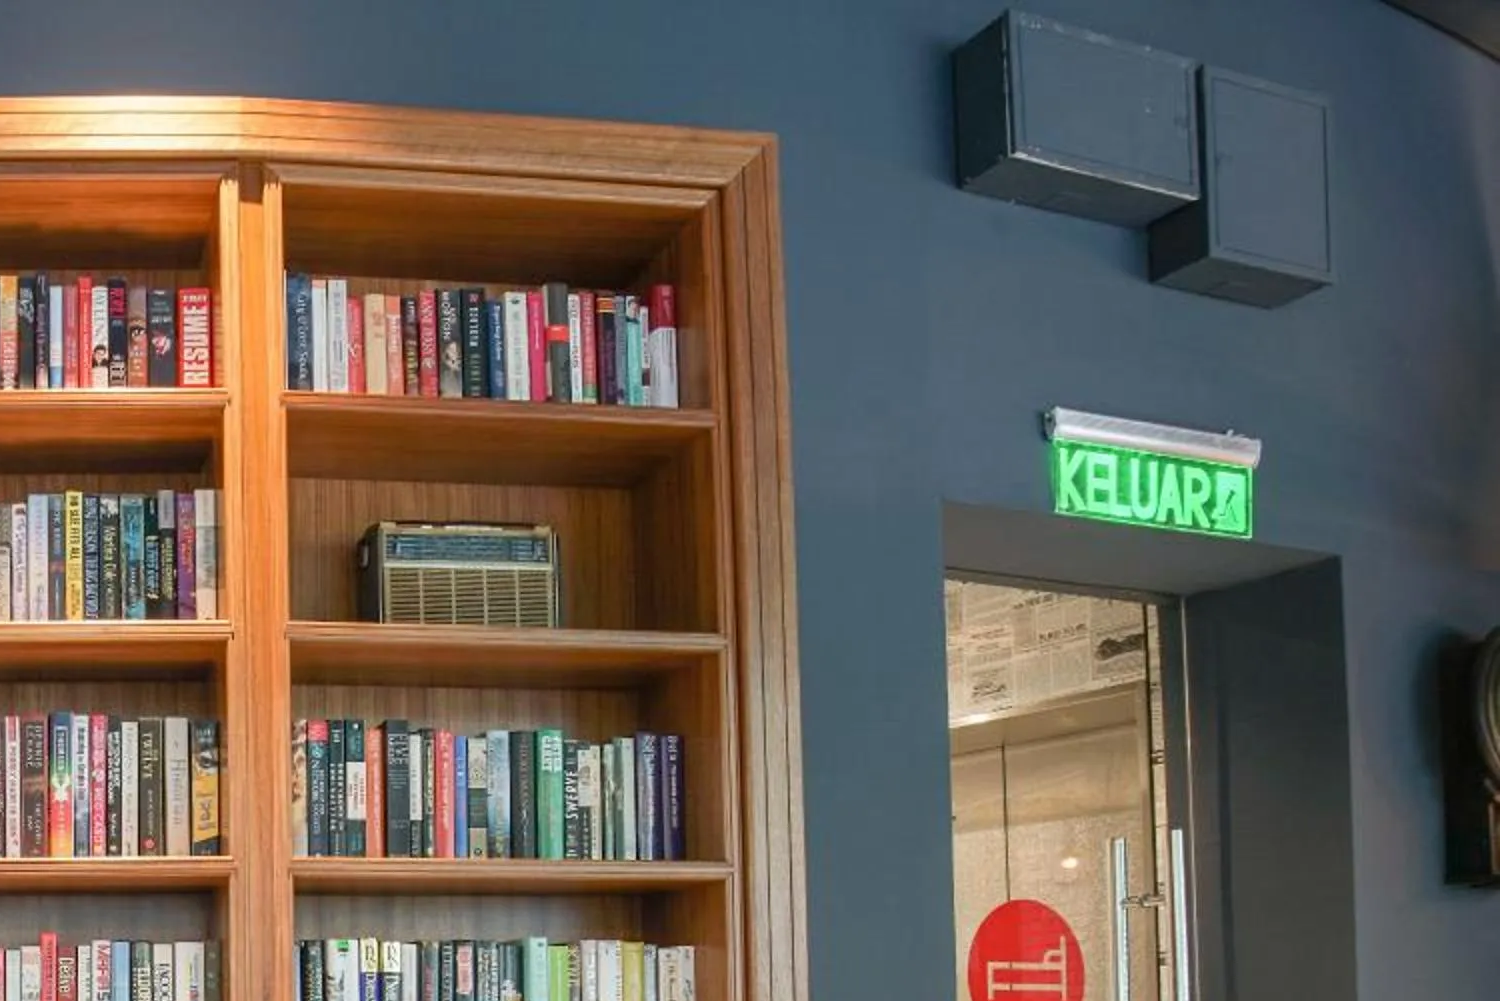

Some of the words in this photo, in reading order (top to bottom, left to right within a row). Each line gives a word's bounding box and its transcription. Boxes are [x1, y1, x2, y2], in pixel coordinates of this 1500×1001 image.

[183, 306, 209, 384] RESUME
[1059, 447, 1211, 529] KELUAR
[70, 547, 79, 560] ALL
[564, 772, 578, 819] SWERVE
